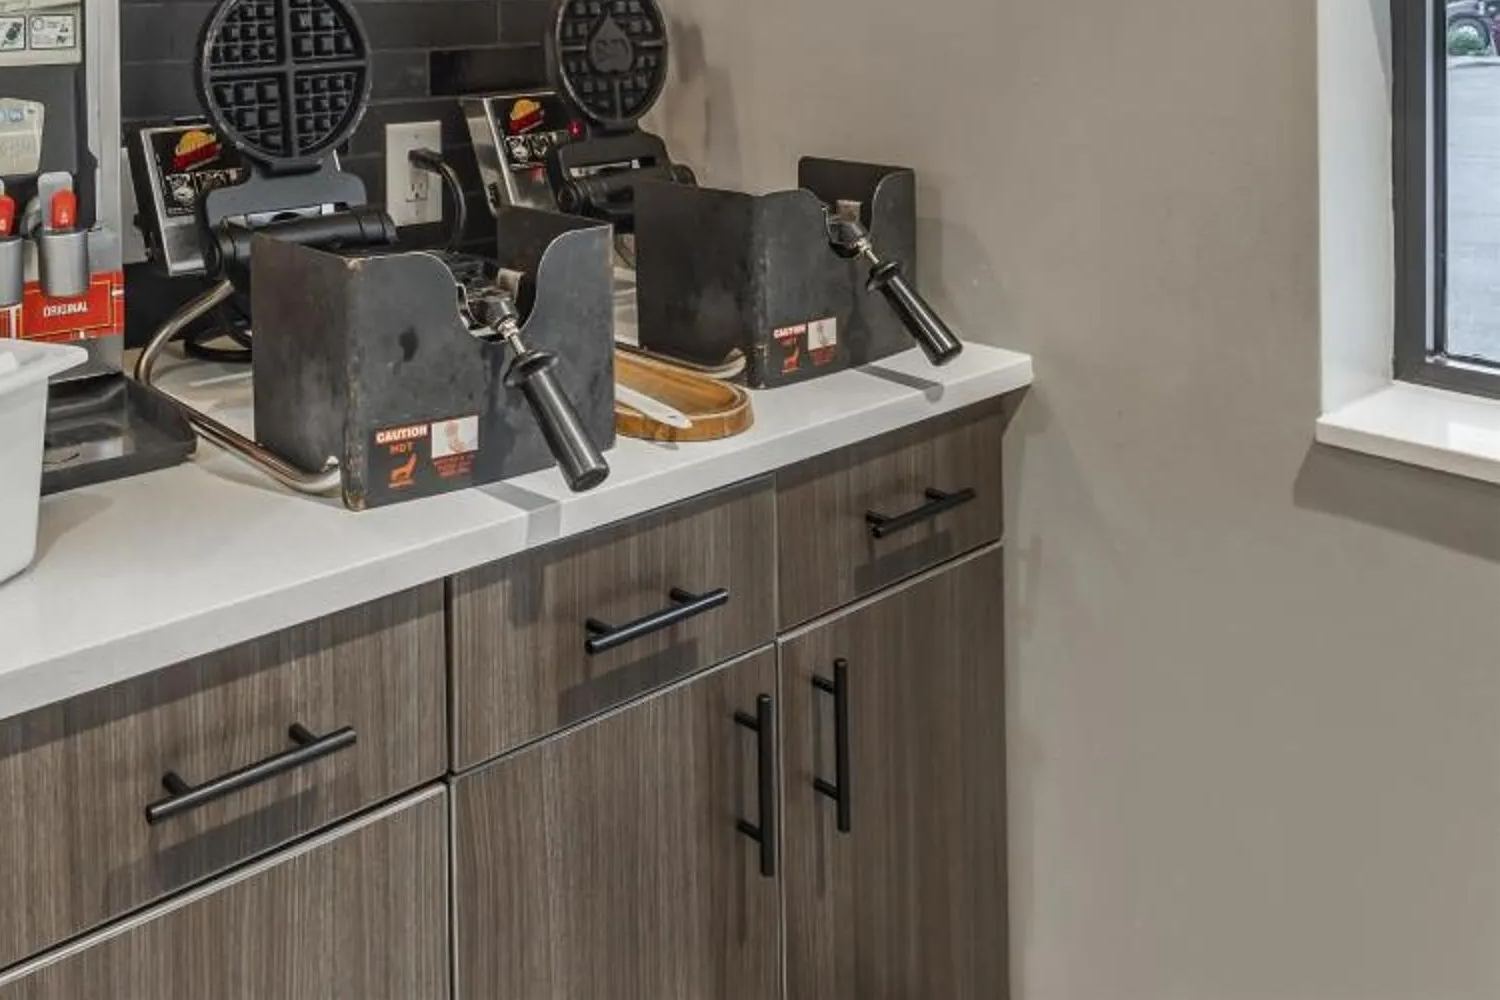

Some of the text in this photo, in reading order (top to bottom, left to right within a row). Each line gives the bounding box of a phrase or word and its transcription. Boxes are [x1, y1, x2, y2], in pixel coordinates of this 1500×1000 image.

[43, 300, 88, 318] ORIGINAL
[375, 424, 428, 444] CAUTION
[390, 441, 414, 454] HOT
